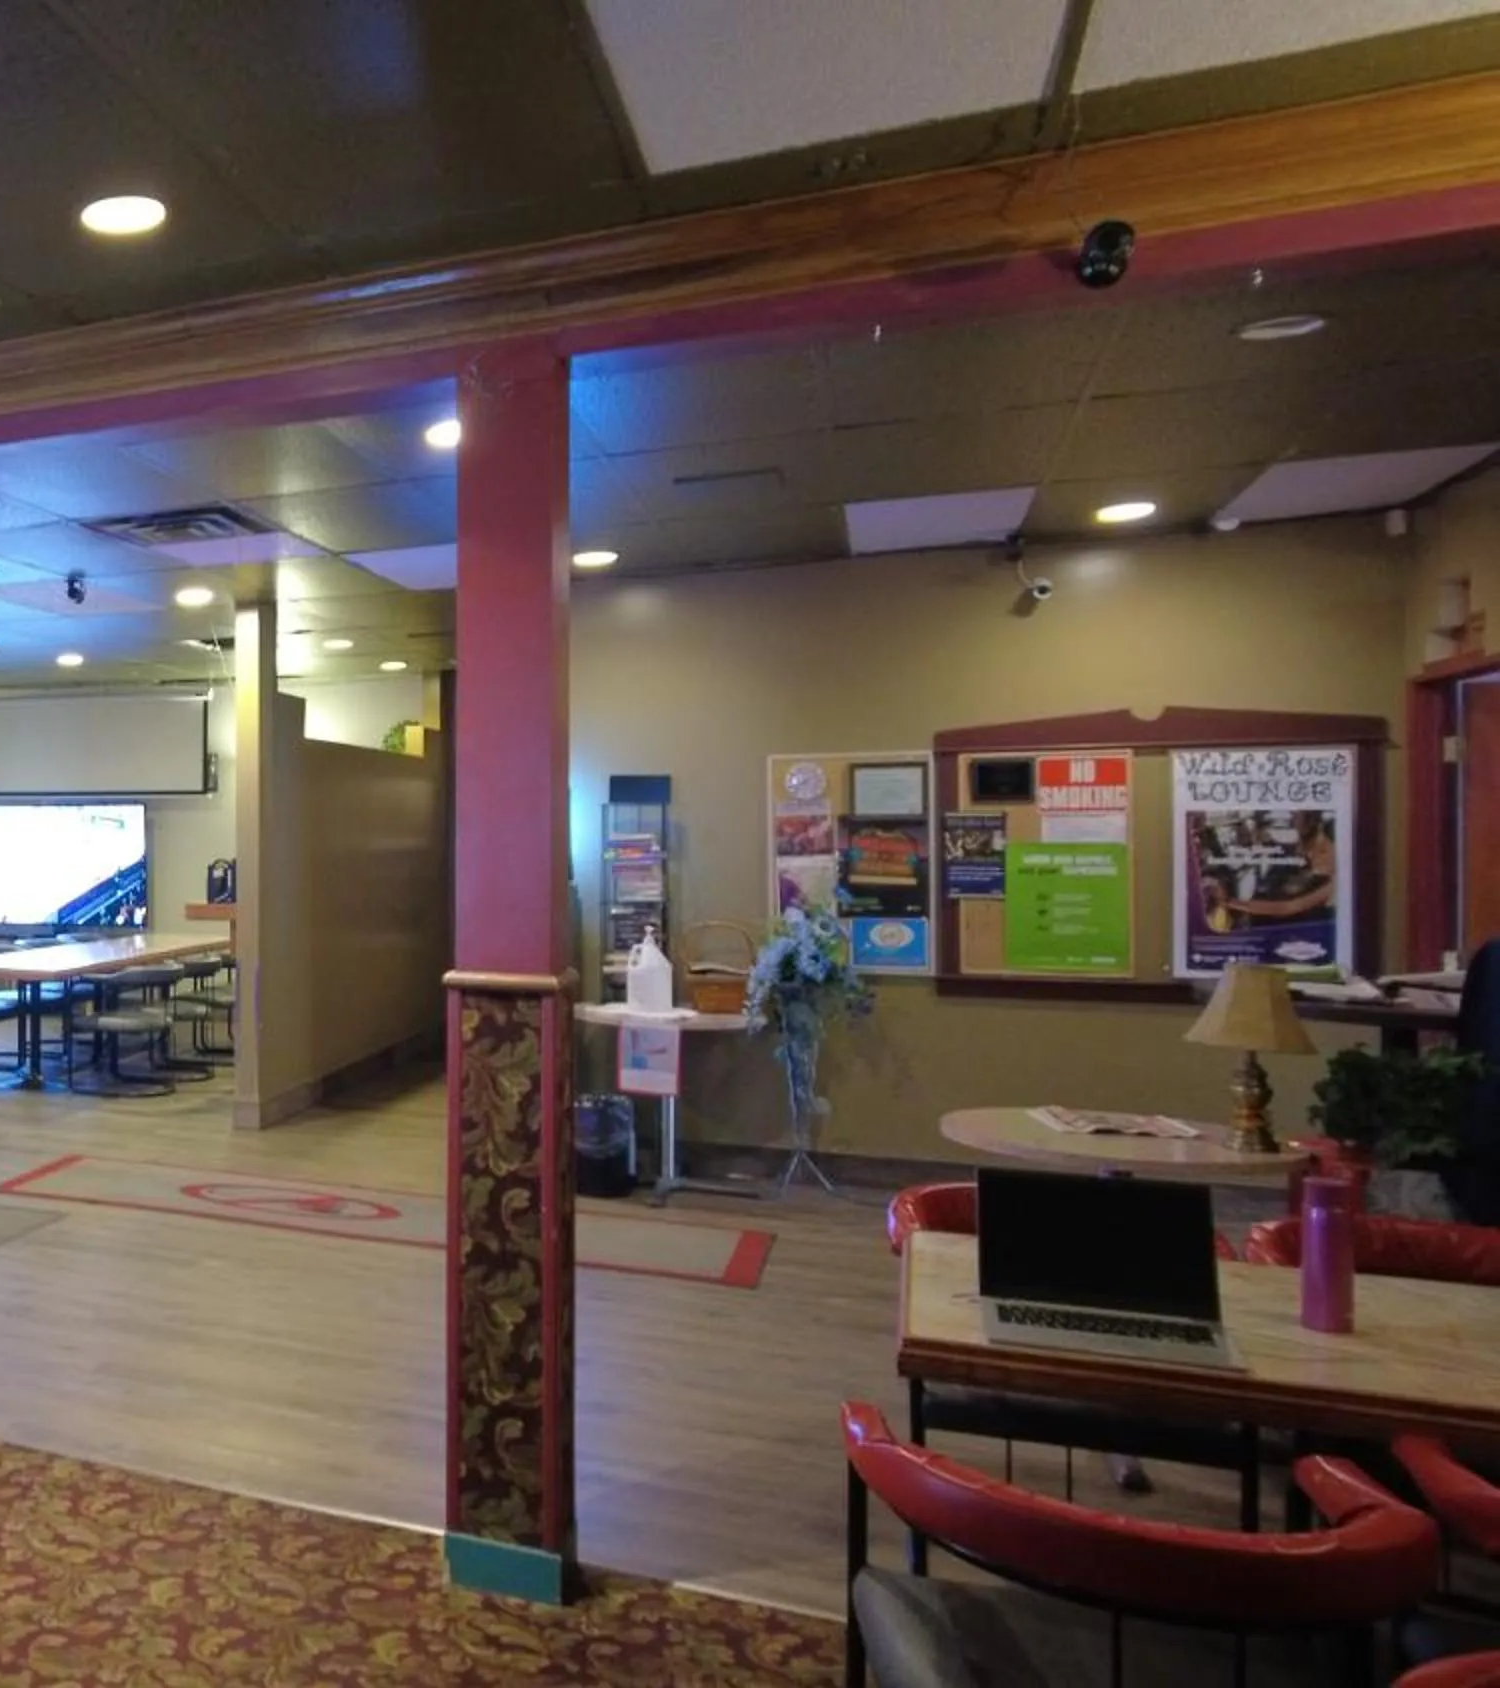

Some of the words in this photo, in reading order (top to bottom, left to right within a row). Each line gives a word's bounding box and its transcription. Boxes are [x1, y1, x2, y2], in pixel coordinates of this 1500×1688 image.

[1069, 757, 1096, 784] NO
[1039, 785, 1128, 809] SMOKING
[1187, 780, 1333, 803] LOUNGE
